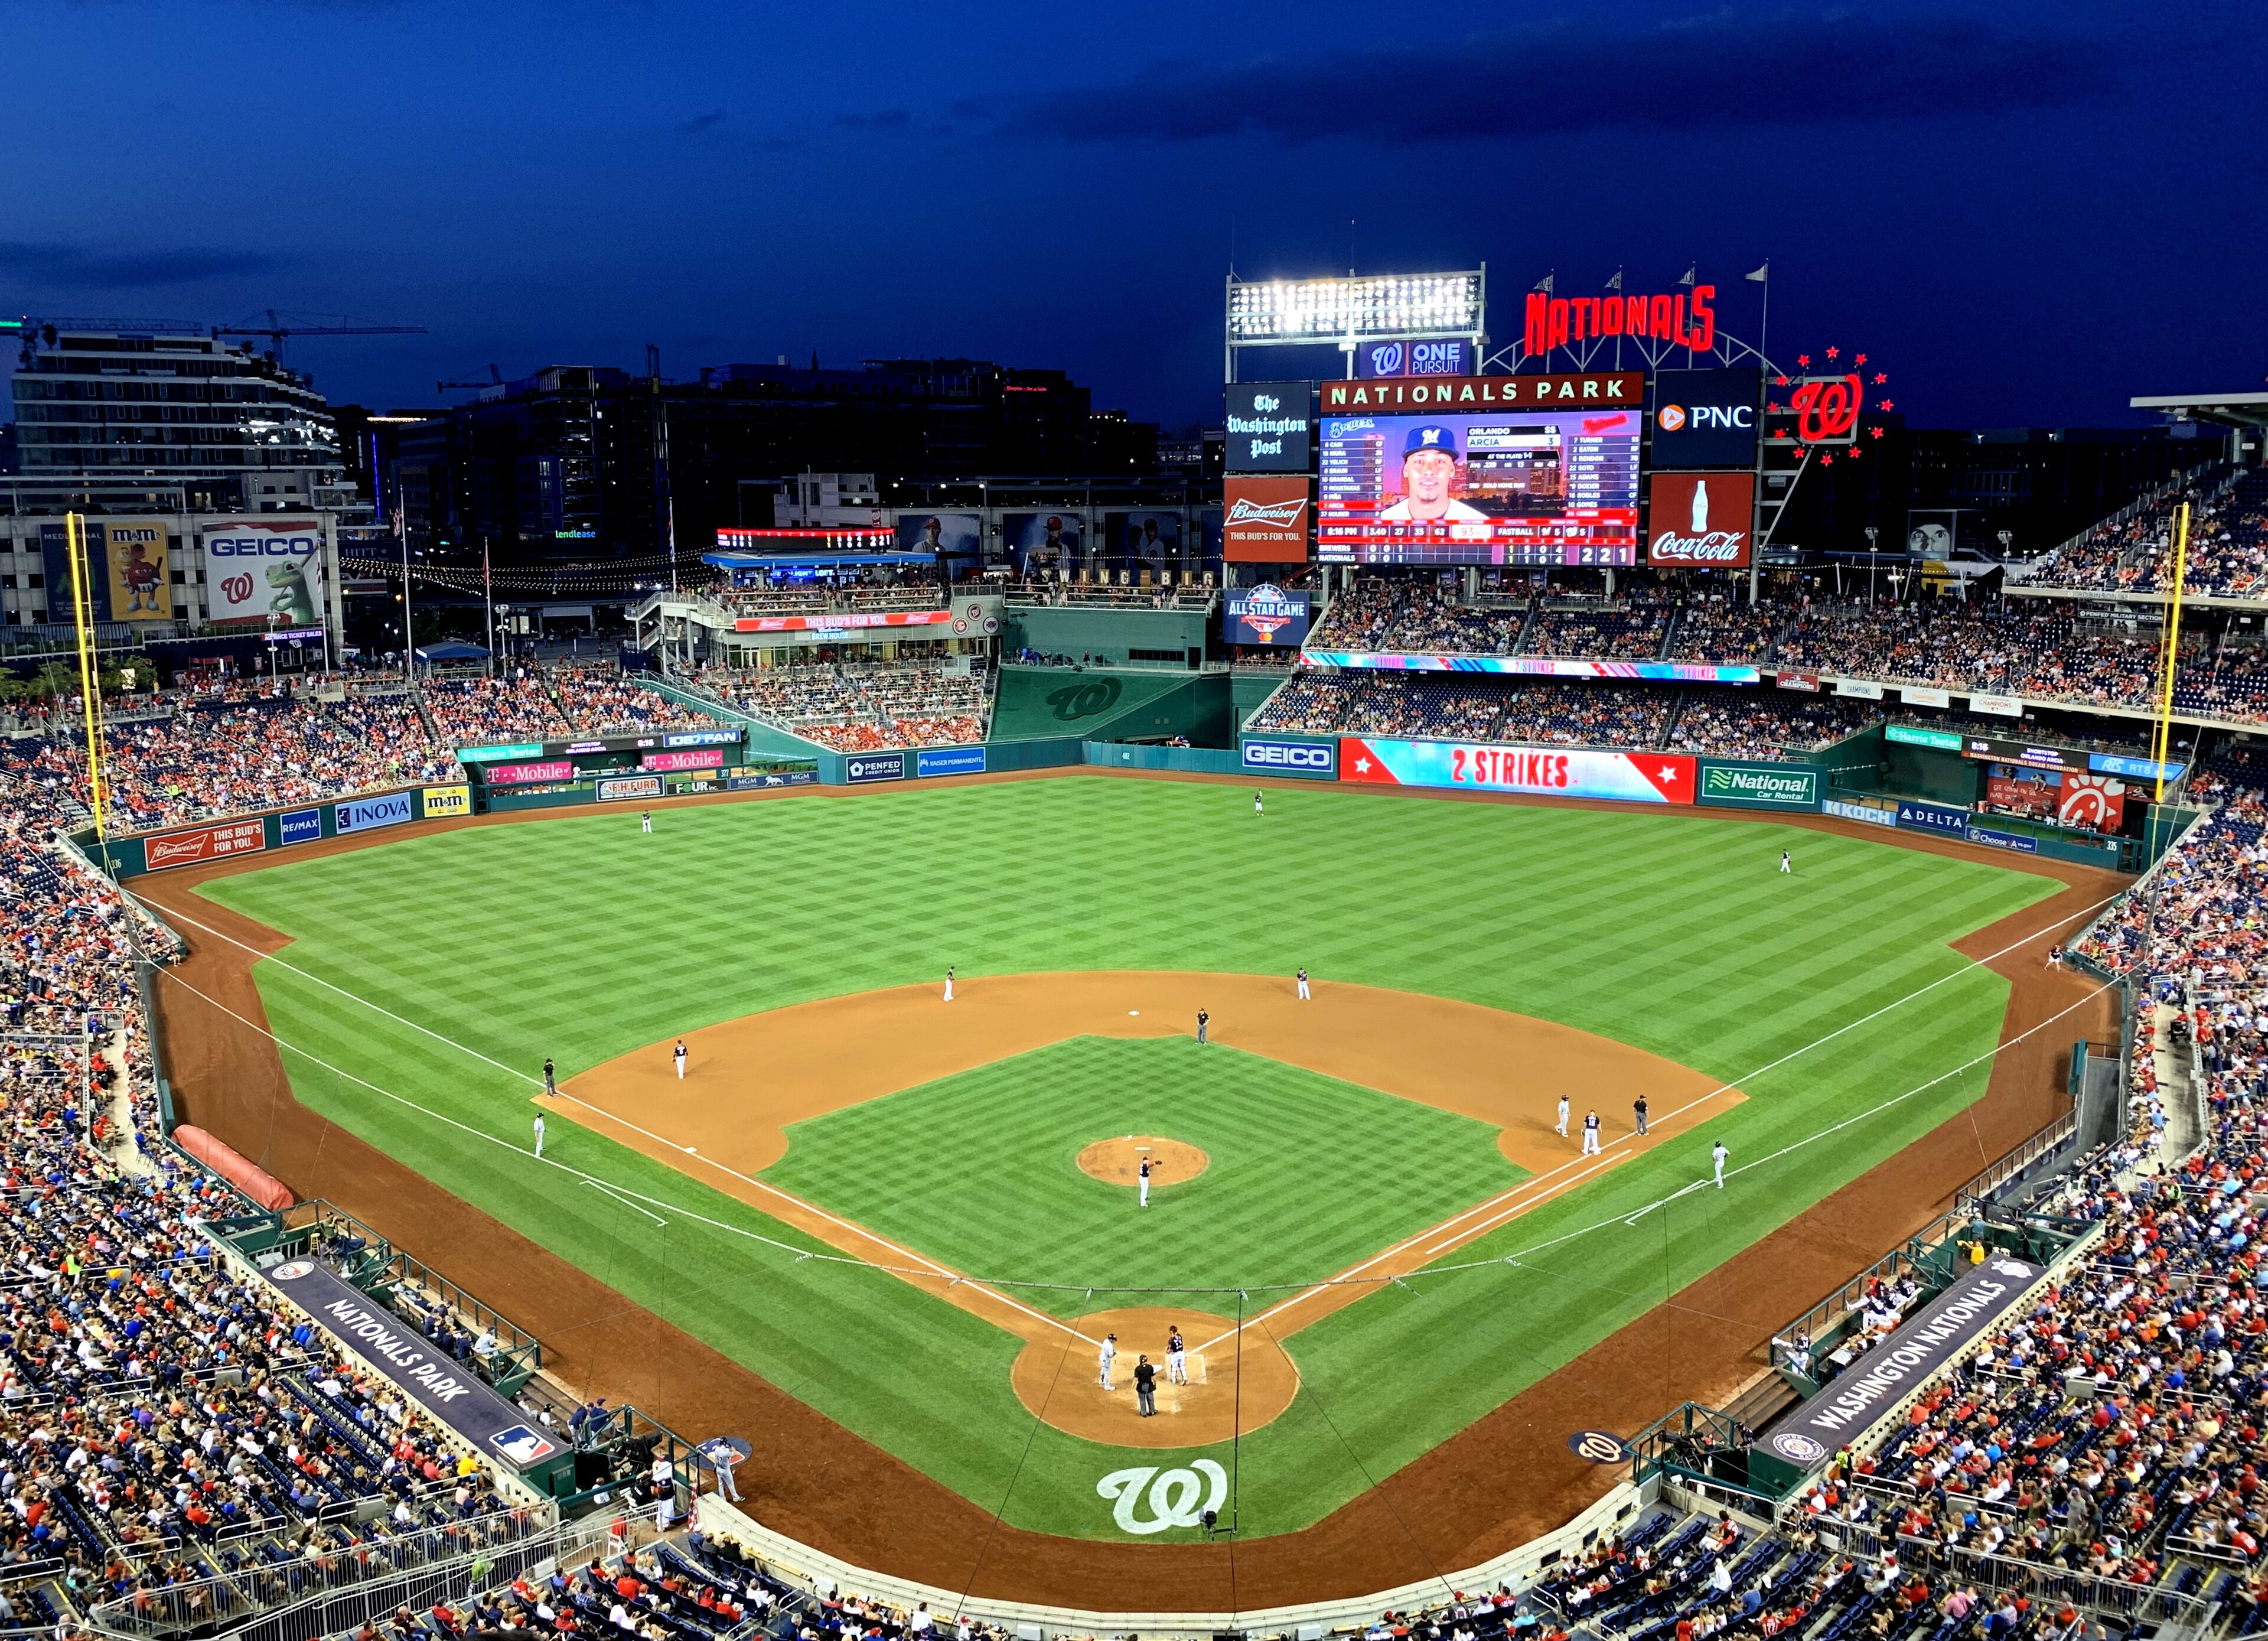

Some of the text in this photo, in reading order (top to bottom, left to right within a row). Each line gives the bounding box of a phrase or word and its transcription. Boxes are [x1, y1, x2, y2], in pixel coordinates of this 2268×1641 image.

[1524, 285, 1715, 356] NATIONALS
[1412, 343, 1461, 361] ONE
[1412, 359, 1461, 375] PURSUIT
[1331, 379, 1624, 406] NATIONALS PARK
[1253, 394, 1280, 413] The
[1690, 405, 1753, 428] PNC
[1227, 413, 1308, 437] Washington
[1329, 418, 1376, 438] Brewers
[1468, 426, 1556, 435] ORLANDO SS
[1250, 439, 1282, 459] Post
[1231, 505, 1298, 519] Budweiser
[555, 529, 596, 539] lendlease
[1230, 532, 1301, 541] THIS BUD'S FOR YOU.
[1327, 527, 1357, 536] 8:16 PM
[1370, 528, 1386, 536] 3.40
[1394, 528, 1404, 536] 27
[1461, 527, 1474, 536] 93
[210, 537, 314, 557] GEICO
[870, 535, 885, 546] 2 2
[1652, 530, 1746, 561] Coca-Cola
[344, 548, 377, 557] HITT
[1370, 554, 1376, 562] 0
[1383, 554, 1390, 562] 0
[1582, 548, 1627, 562] 2 2 1
[2078, 591, 2117, 600] ROBINSON
[1228, 602, 1305, 616] ALL STAR GAME
[804, 614, 888, 627] THIS BUD'S FOR YOU.
[288, 630, 322, 639] TICKET SALES
[1367, 656, 1405, 668] 2 STRIKES
[1515, 661, 1555, 673] 2 STRIKES
[1682, 666, 1716, 679] STRIKES
[1780, 681, 1815, 690] CHAMPIONS
[1847, 685, 1871, 695] CHAMPIONS
[1978, 699, 2012, 709] CHAMPIONS
[703, 732, 736, 742] FAN
[1898, 731, 1960, 748] Harris Teeter
[1971, 741, 1989, 751] 8:16
[2026, 747, 2059, 757] SHORTSTOP
[474, 747, 540, 760] Harris Teeter
[1122, 752, 1130, 760] 402
[1245, 744, 1331, 767] GEICO
[2020, 753, 2047, 762] ORLANDO
[865, 760, 901, 770] PENFED
[930, 759, 948, 767] KAISER
[1452, 749, 1569, 789] 2 STRIKES
[1969, 752, 2079, 773] WASHINGTON NATIONALS DREAM FOUNDATION
[721, 769, 729, 777] 377
[1731, 773, 1807, 793] National
[1757, 790, 1804, 801] Car Rental
[356, 800, 409, 823] INOVA
[1842, 802, 1891, 826] KOCH
[282, 819, 318, 833] RE/MAX
[1915, 810, 1963, 829] DELTA
[213, 823, 262, 842] THIS BUD'S
[154, 842, 203, 857] Budweiser
[213, 837, 254, 854] FOR YOU.
[2106, 840, 2118, 852] 335
[110, 858, 122, 870] 336
[324, 1298, 471, 1404] NATIONALS PARK
[1810, 1279, 2007, 1431] WASHINGTON NATIONALS
